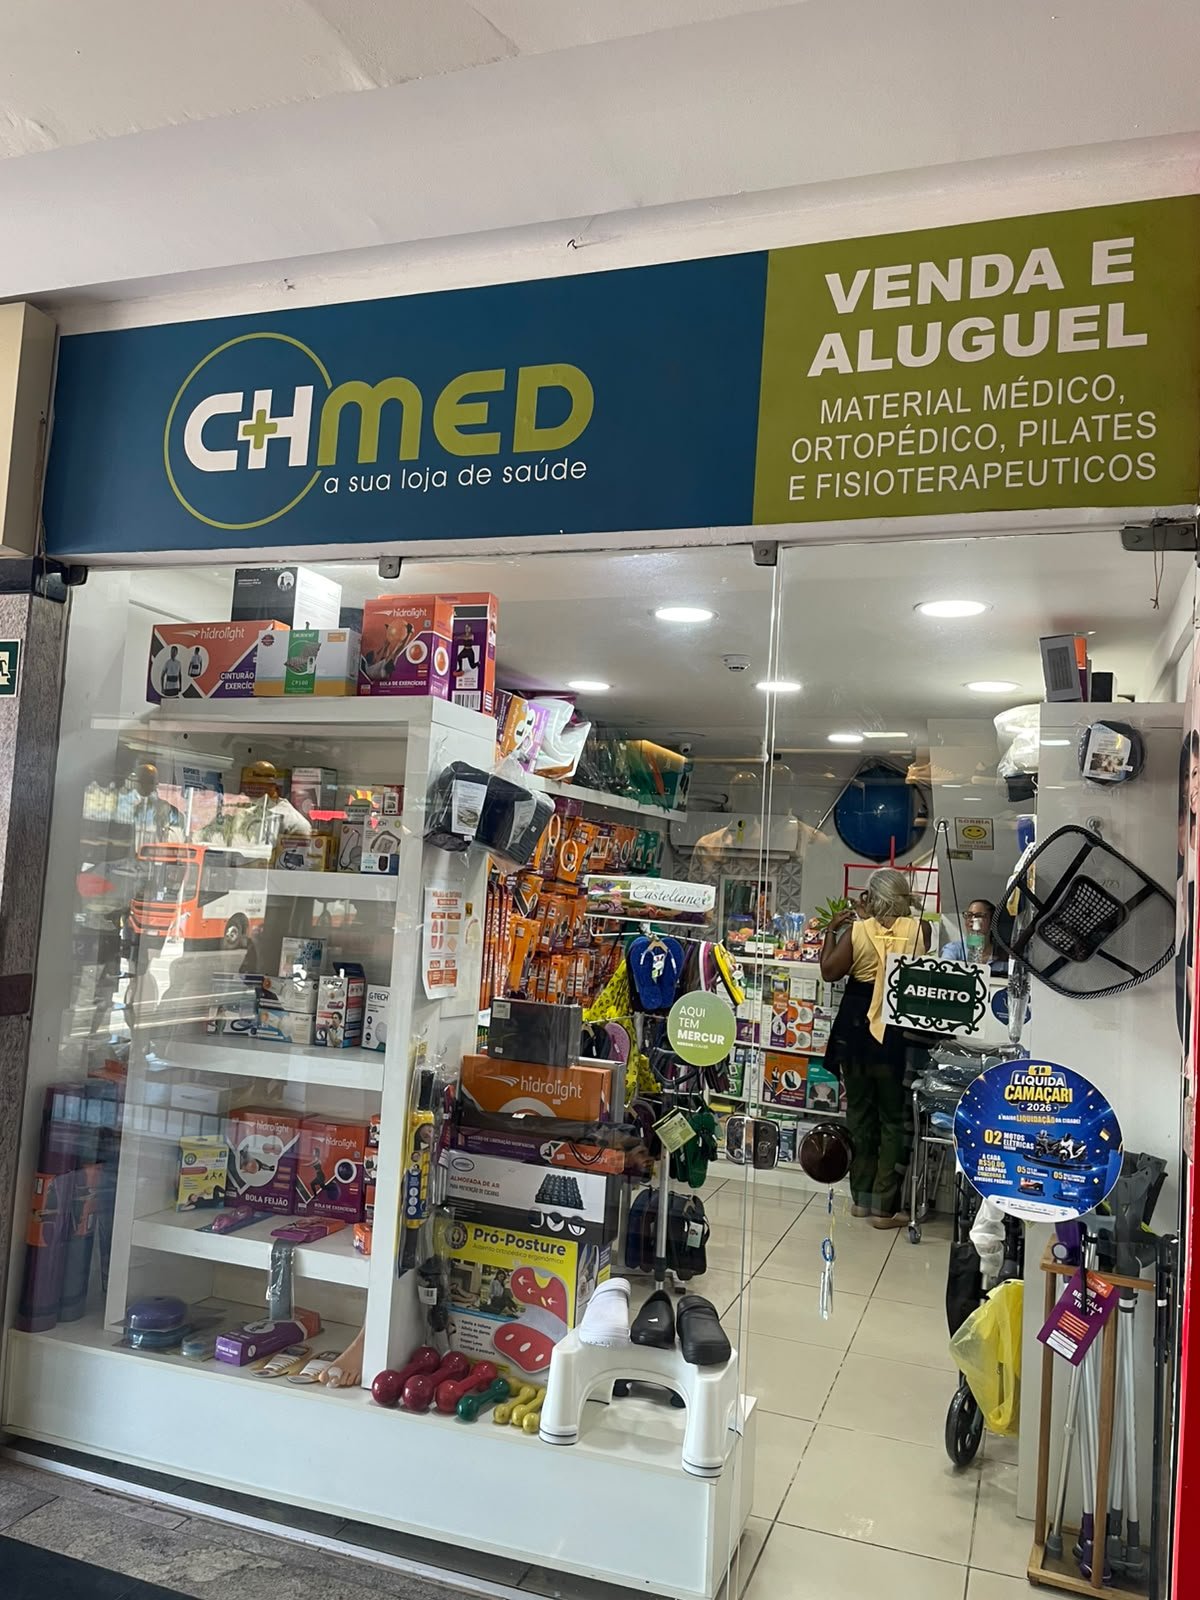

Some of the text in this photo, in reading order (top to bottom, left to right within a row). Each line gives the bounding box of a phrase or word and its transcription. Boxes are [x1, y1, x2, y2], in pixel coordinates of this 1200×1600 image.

[824, 236, 1135, 315] VENDA E
[806, 302, 1149, 378] ALUGUEL
[819, 373, 1125, 425] MATERIAL MÉDICO,
[790, 410, 1158, 464] ORTOPÉDICO, PILATES
[323, 457, 588, 495] a sua loja de saúde
[788, 451, 1158, 501] E FISIOTERAPEUTICOS
[392, 607, 427, 619] hidrolight
[200, 626, 245, 642] hidrolight
[220, 670, 255, 681] CINTURÃO
[903, 983, 971, 1004] ABERTO
[679, 1005, 706, 1018] AQUI
[678, 1017, 700, 1029] TEM
[677, 1029, 725, 1046] MERCUR
[520, 1075, 583, 1101] hidrolight
[1013, 1073, 1065, 1087] LIQUIDA
[1004, 1084, 1073, 1104] CAMAÇARI
[1026, 1103, 1052, 1112] 2026
[325, 1136, 357, 1149] hidrolight
[984, 1129, 1003, 1146] 02
[1003, 1132, 1026, 1142] MOTOS
[1003, 1139, 1035, 1150] ELÉTRICAS
[450, 1175, 481, 1186] ALMOFADA
[245, 1193, 288, 1207] BOLA FEIJÃO
[473, 1227, 567, 1256] Pró-Posture
[1072, 1289, 1103, 1314] BEGALA
